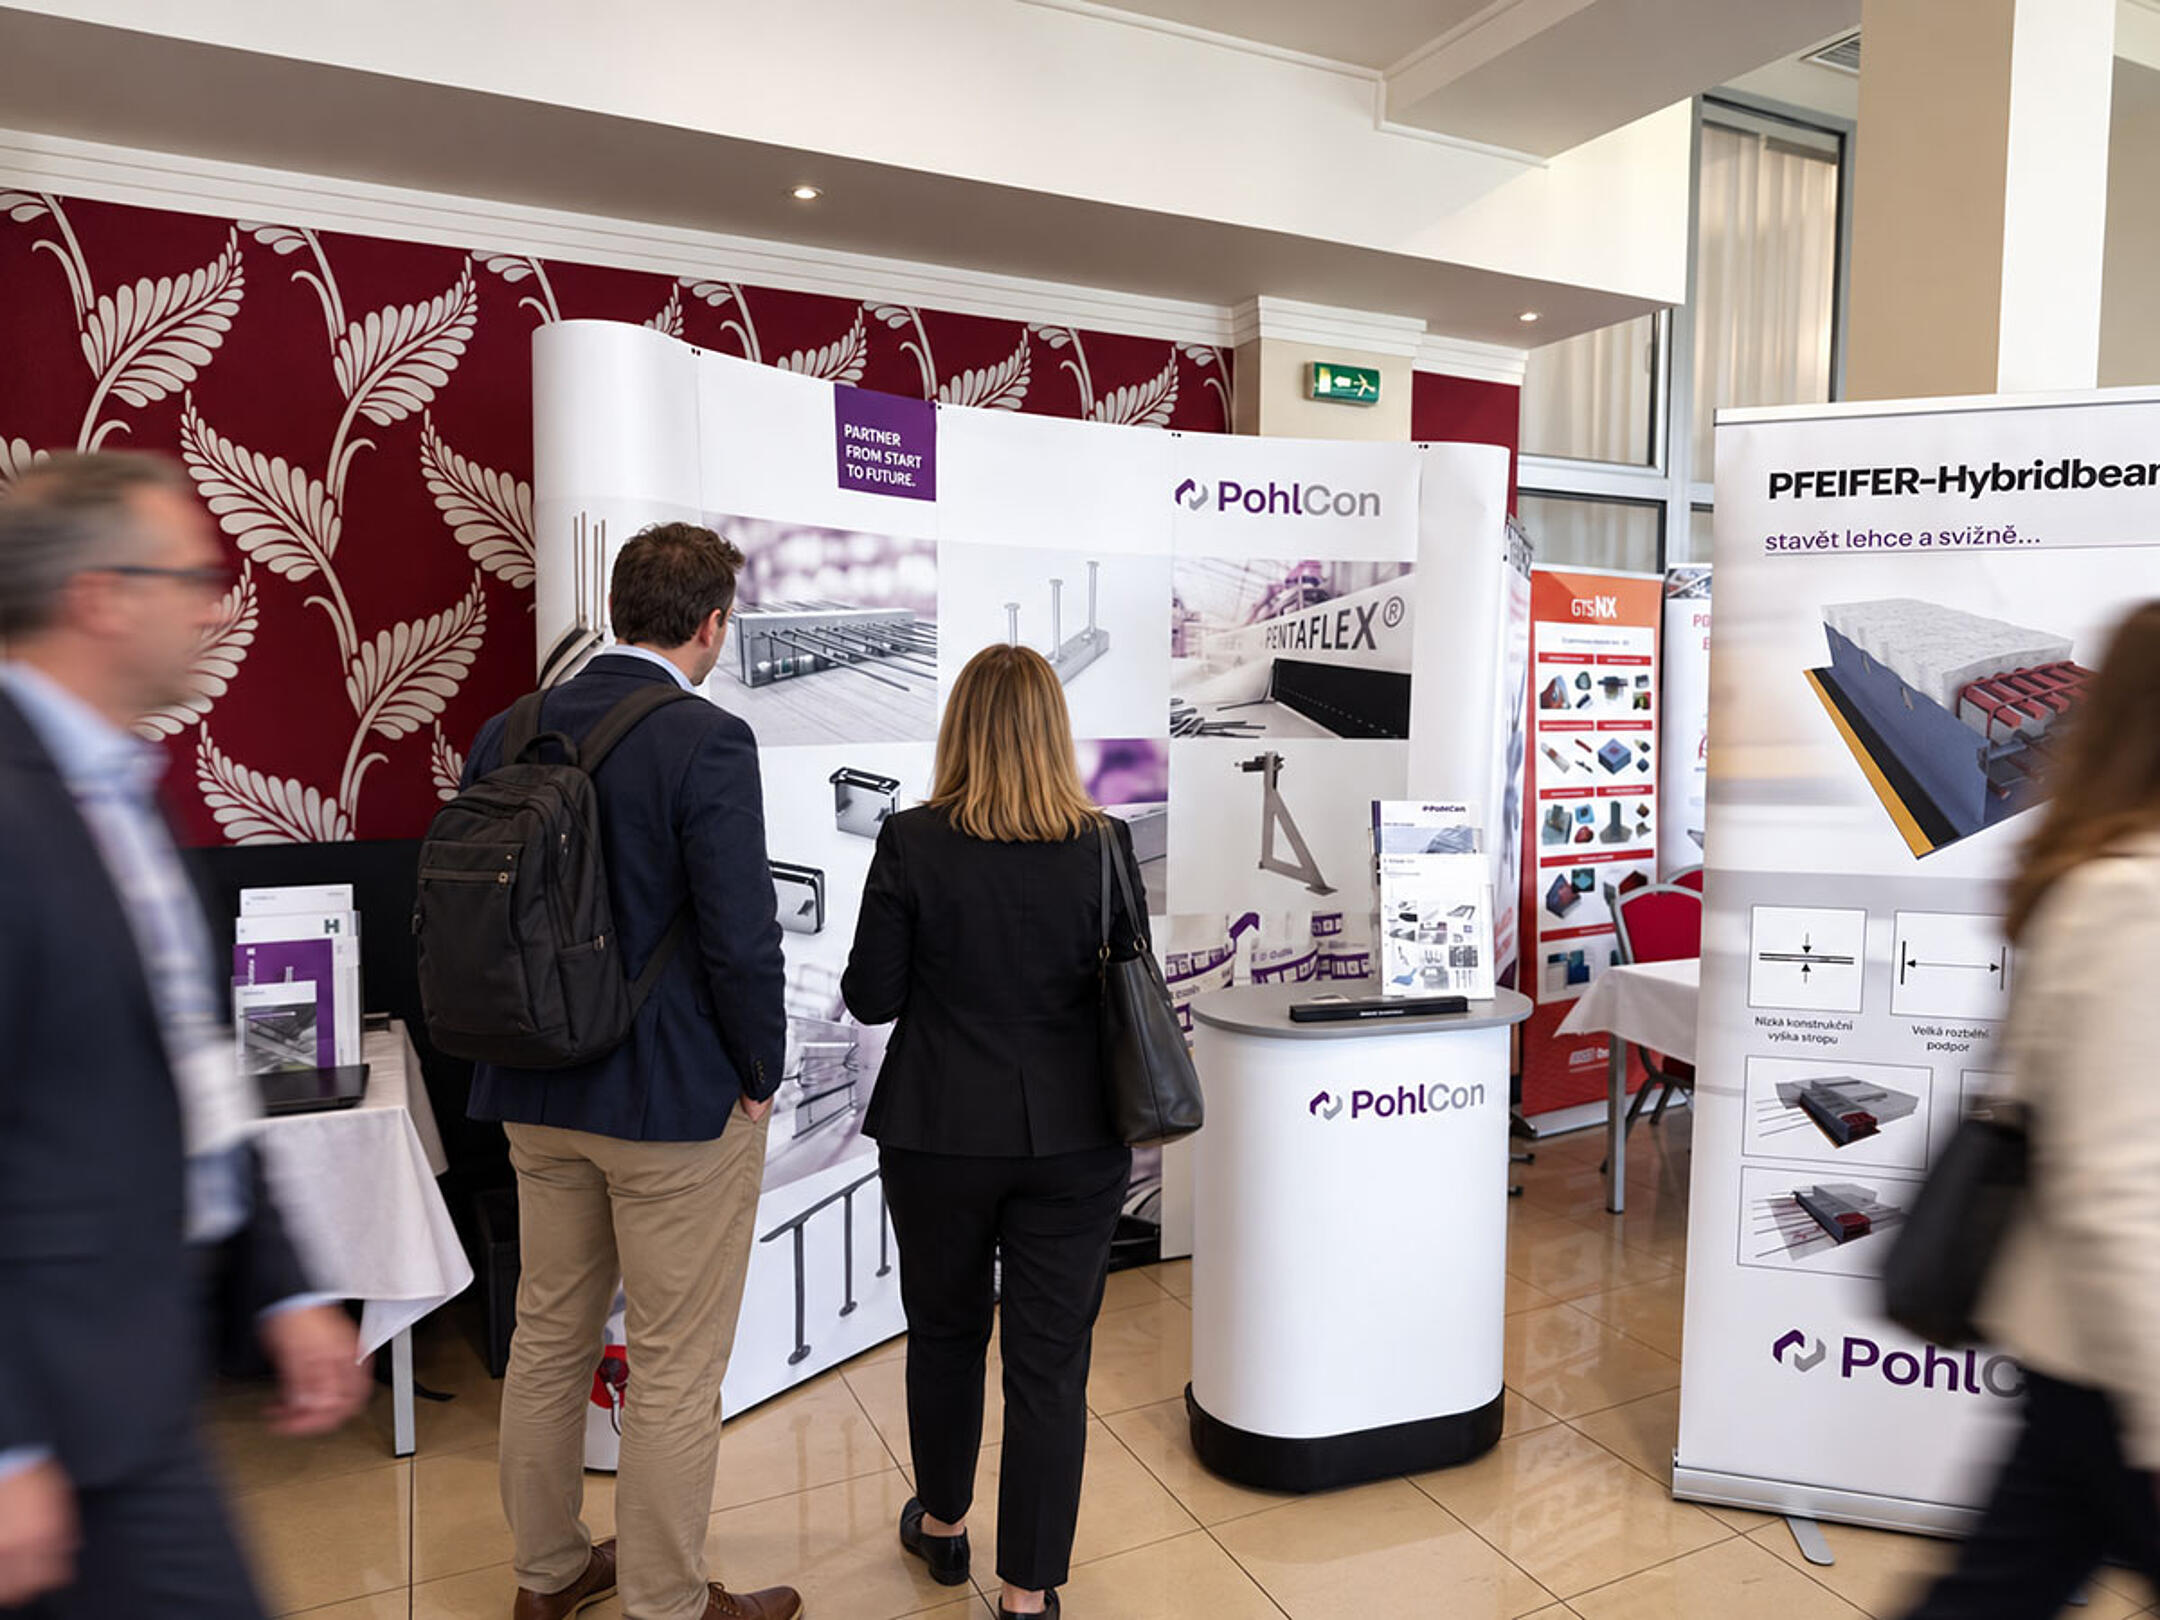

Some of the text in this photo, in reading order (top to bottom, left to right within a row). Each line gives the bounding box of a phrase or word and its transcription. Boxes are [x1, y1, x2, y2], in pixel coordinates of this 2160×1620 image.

[844, 424, 901, 447] PARTNER
[846, 445, 922, 468] FROM START
[846, 463, 916, 487] TO FUTURE.
[1218, 481, 1381, 516] PohlCon
[1765, 524, 2041, 551] stavět lehce a svižně...
[1927, 1041, 1970, 1052] podpor
[1351, 1083, 1484, 1119] PohlCon
[1842, 1337, 2025, 1398] PohlC
